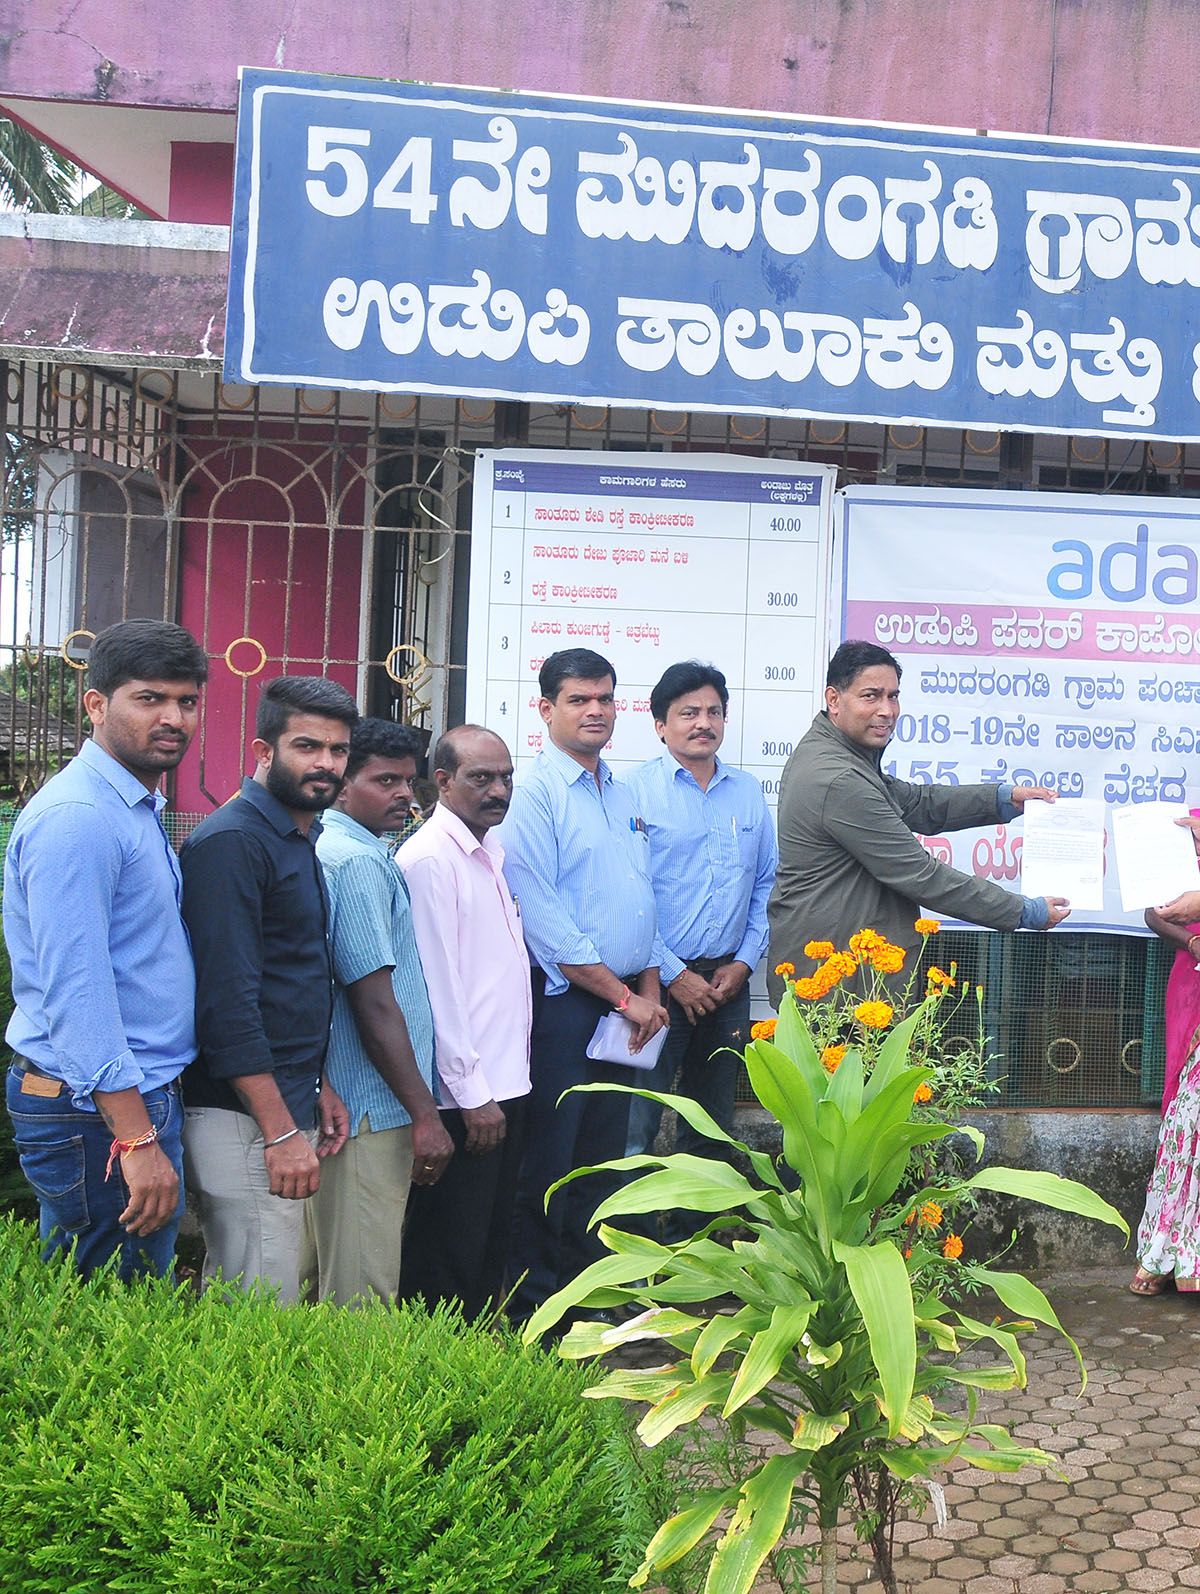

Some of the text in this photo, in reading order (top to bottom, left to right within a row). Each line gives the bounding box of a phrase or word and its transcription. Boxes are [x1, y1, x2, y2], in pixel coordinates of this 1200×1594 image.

[305, 117, 550, 235] 54ನೇ
[577, 131, 999, 271] ಮುದರಂಗಡಿ
[322, 269, 590, 365] ಉಡುಪಿ
[616, 296, 954, 391] ತಾಲೂಕು
[976, 308, 1164, 426] ಮತ್ತು
[661, 477, 687, 488] ಹೆಸರು
[505, 504, 511, 518] 1
[535, 507, 580, 522] ಸಾಂತೂರು
[770, 517, 801, 532] 40.00
[533, 545, 579, 560] ಸಾಂತೂರು
[650, 547, 669, 564] ಮನೆ
[504, 571, 511, 585] 2
[767, 592, 798, 607] 30.00
[874, 605, 978, 647] ಉಡುಪಿ
[991, 607, 1083, 650] ಪವರ್
[501, 636, 509, 649] 3
[764, 666, 796, 681] 30.00
[920, 664, 1050, 698] ಮುದರಂಗಡಿ
[1064, 670, 1125, 710] ಗ್ರಾಮ
[499, 701, 508, 715] 4
[890, 714, 1040, 748] 018-19ನೇ
[1056, 718, 1137, 751] ಸಾಲಿನ
[762, 741, 793, 756] 30.00
